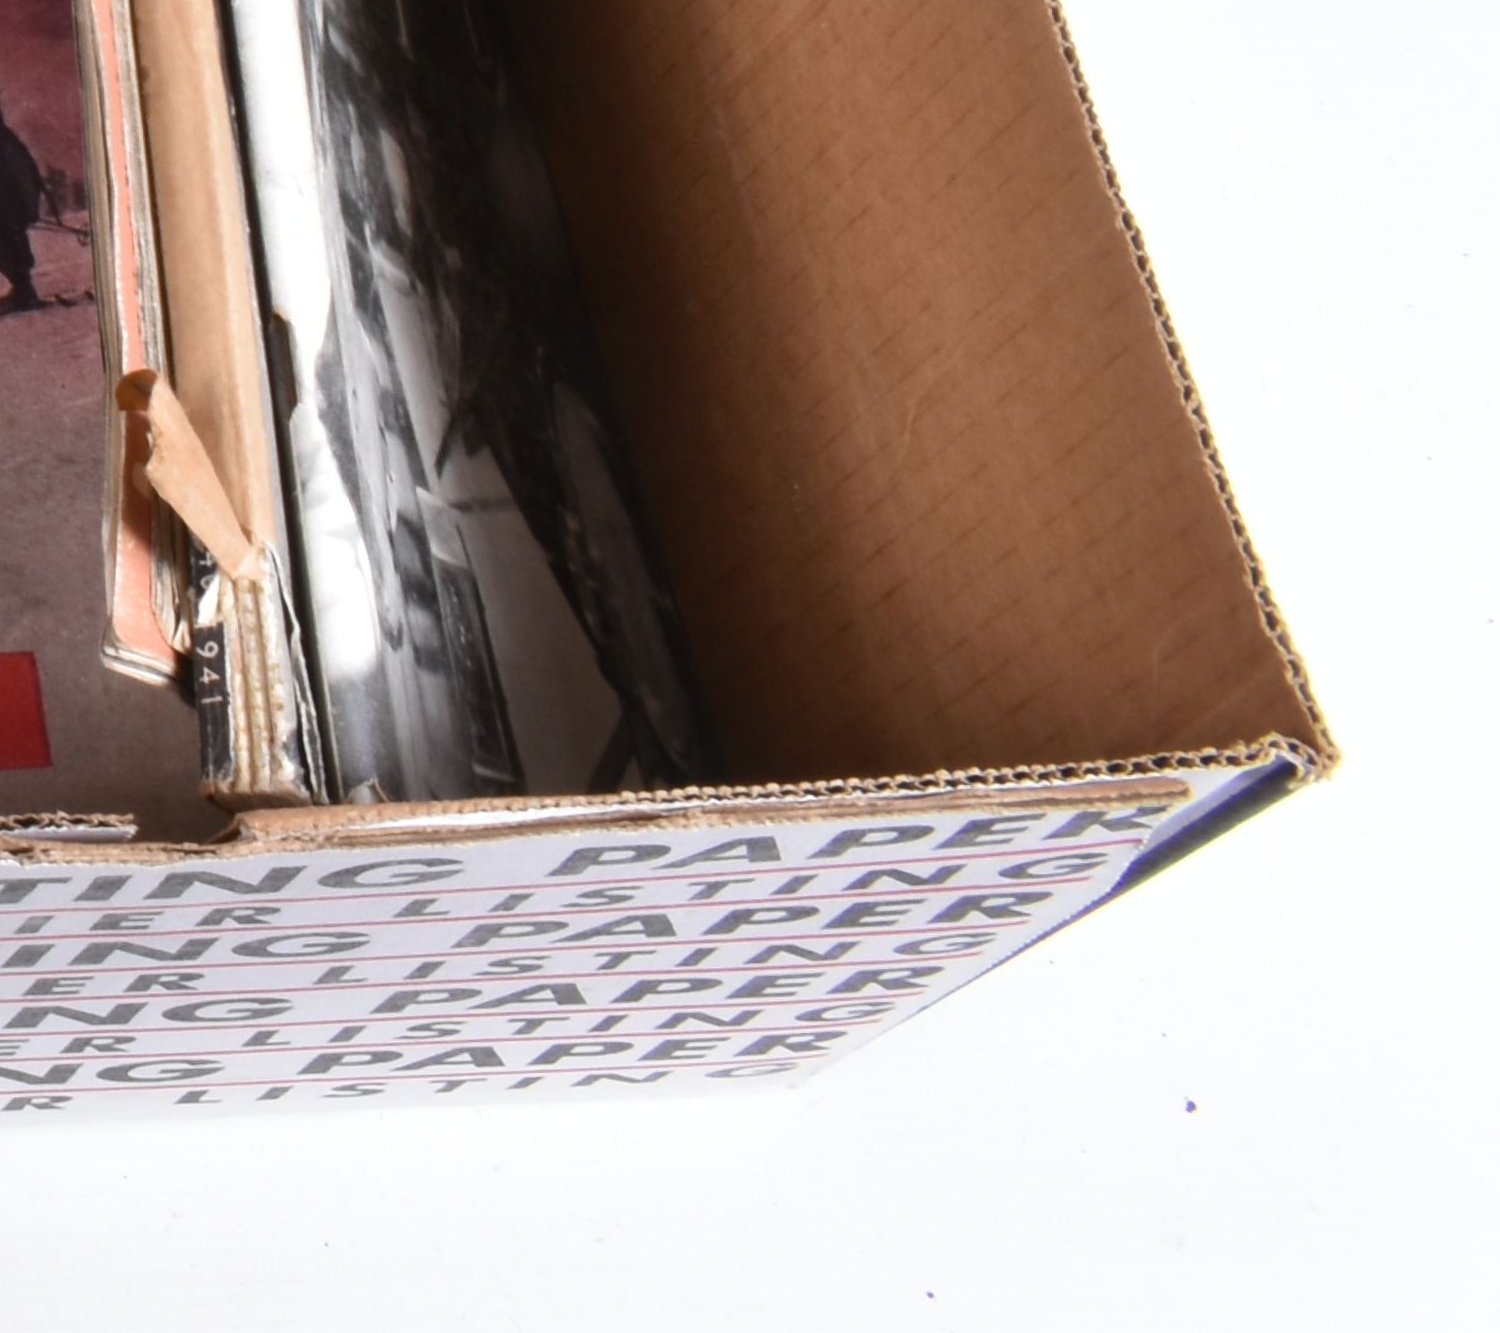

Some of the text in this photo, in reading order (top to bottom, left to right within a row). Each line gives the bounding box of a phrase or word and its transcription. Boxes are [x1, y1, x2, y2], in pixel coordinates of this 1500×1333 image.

[543, 804, 1171, 878] PAPER
[392, 851, 1110, 919] LISTING
[450, 889, 1055, 950] PAPER
[311, 932, 1002, 986] LISTING
[368, 964, 947, 1016] PAPER
[240, 1000, 899, 1049] LISTING
[296, 1029, 850, 1076] PAPER
[174, 1061, 803, 1106] LISTING
